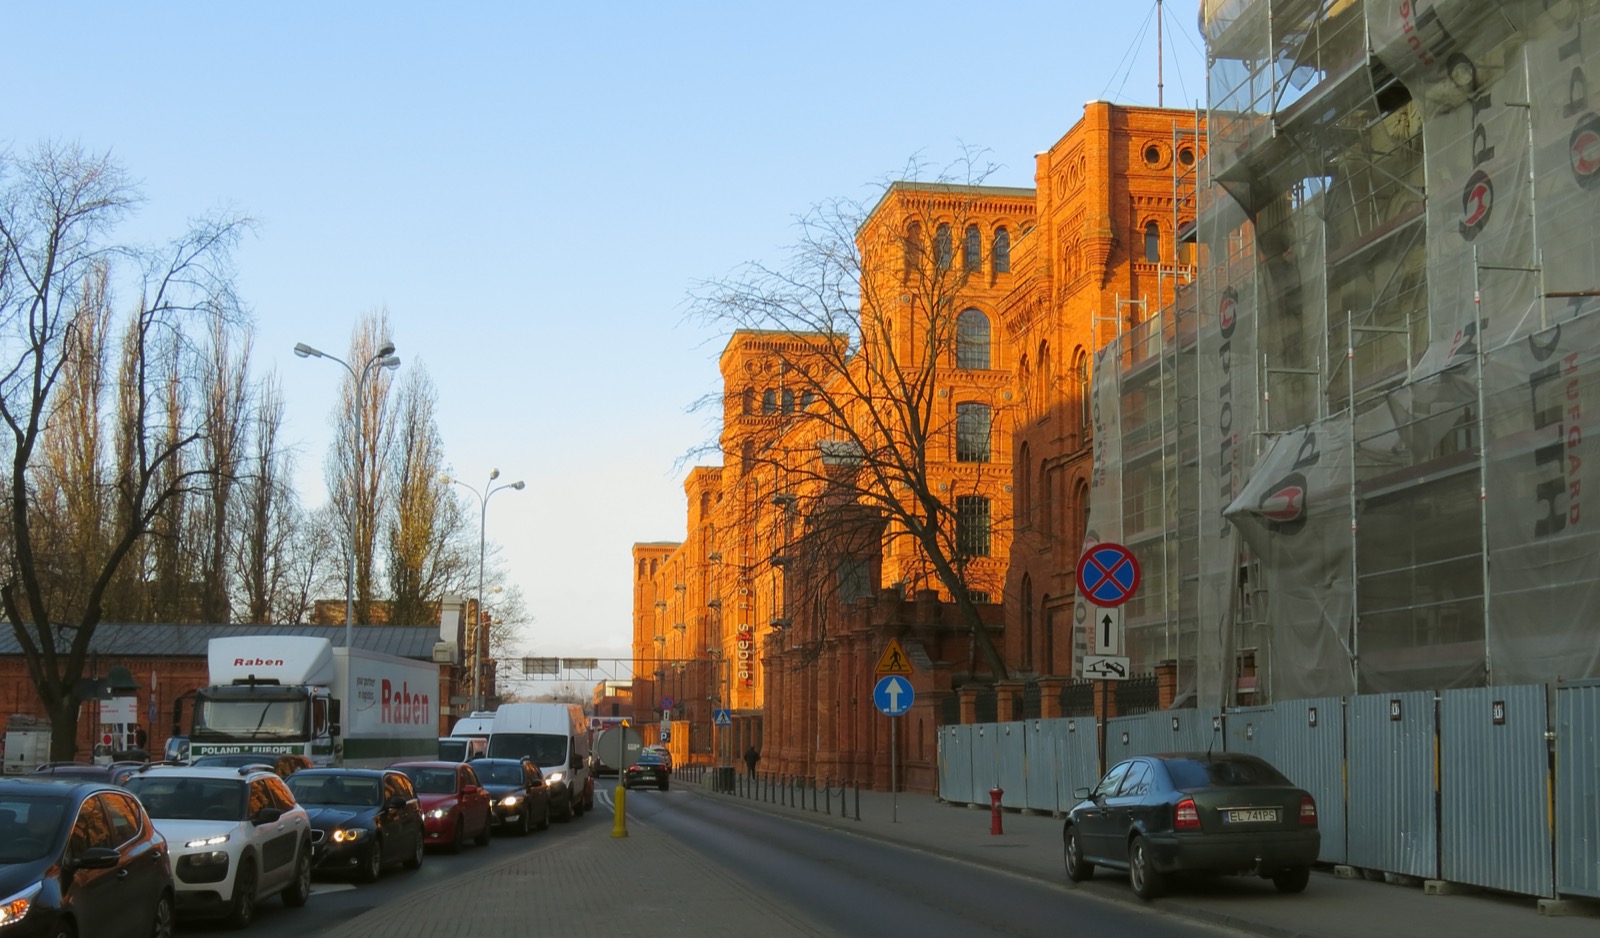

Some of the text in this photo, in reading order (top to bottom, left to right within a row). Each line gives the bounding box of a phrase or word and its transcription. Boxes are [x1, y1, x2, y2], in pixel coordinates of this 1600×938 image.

[1563, 352, 1583, 526] HUFGARD
[234, 657, 284, 667] Raben
[381, 679, 429, 725] Raben
[201, 746, 293, 755] POLAND EUROPE
[1230, 811, 1244, 821] EL
